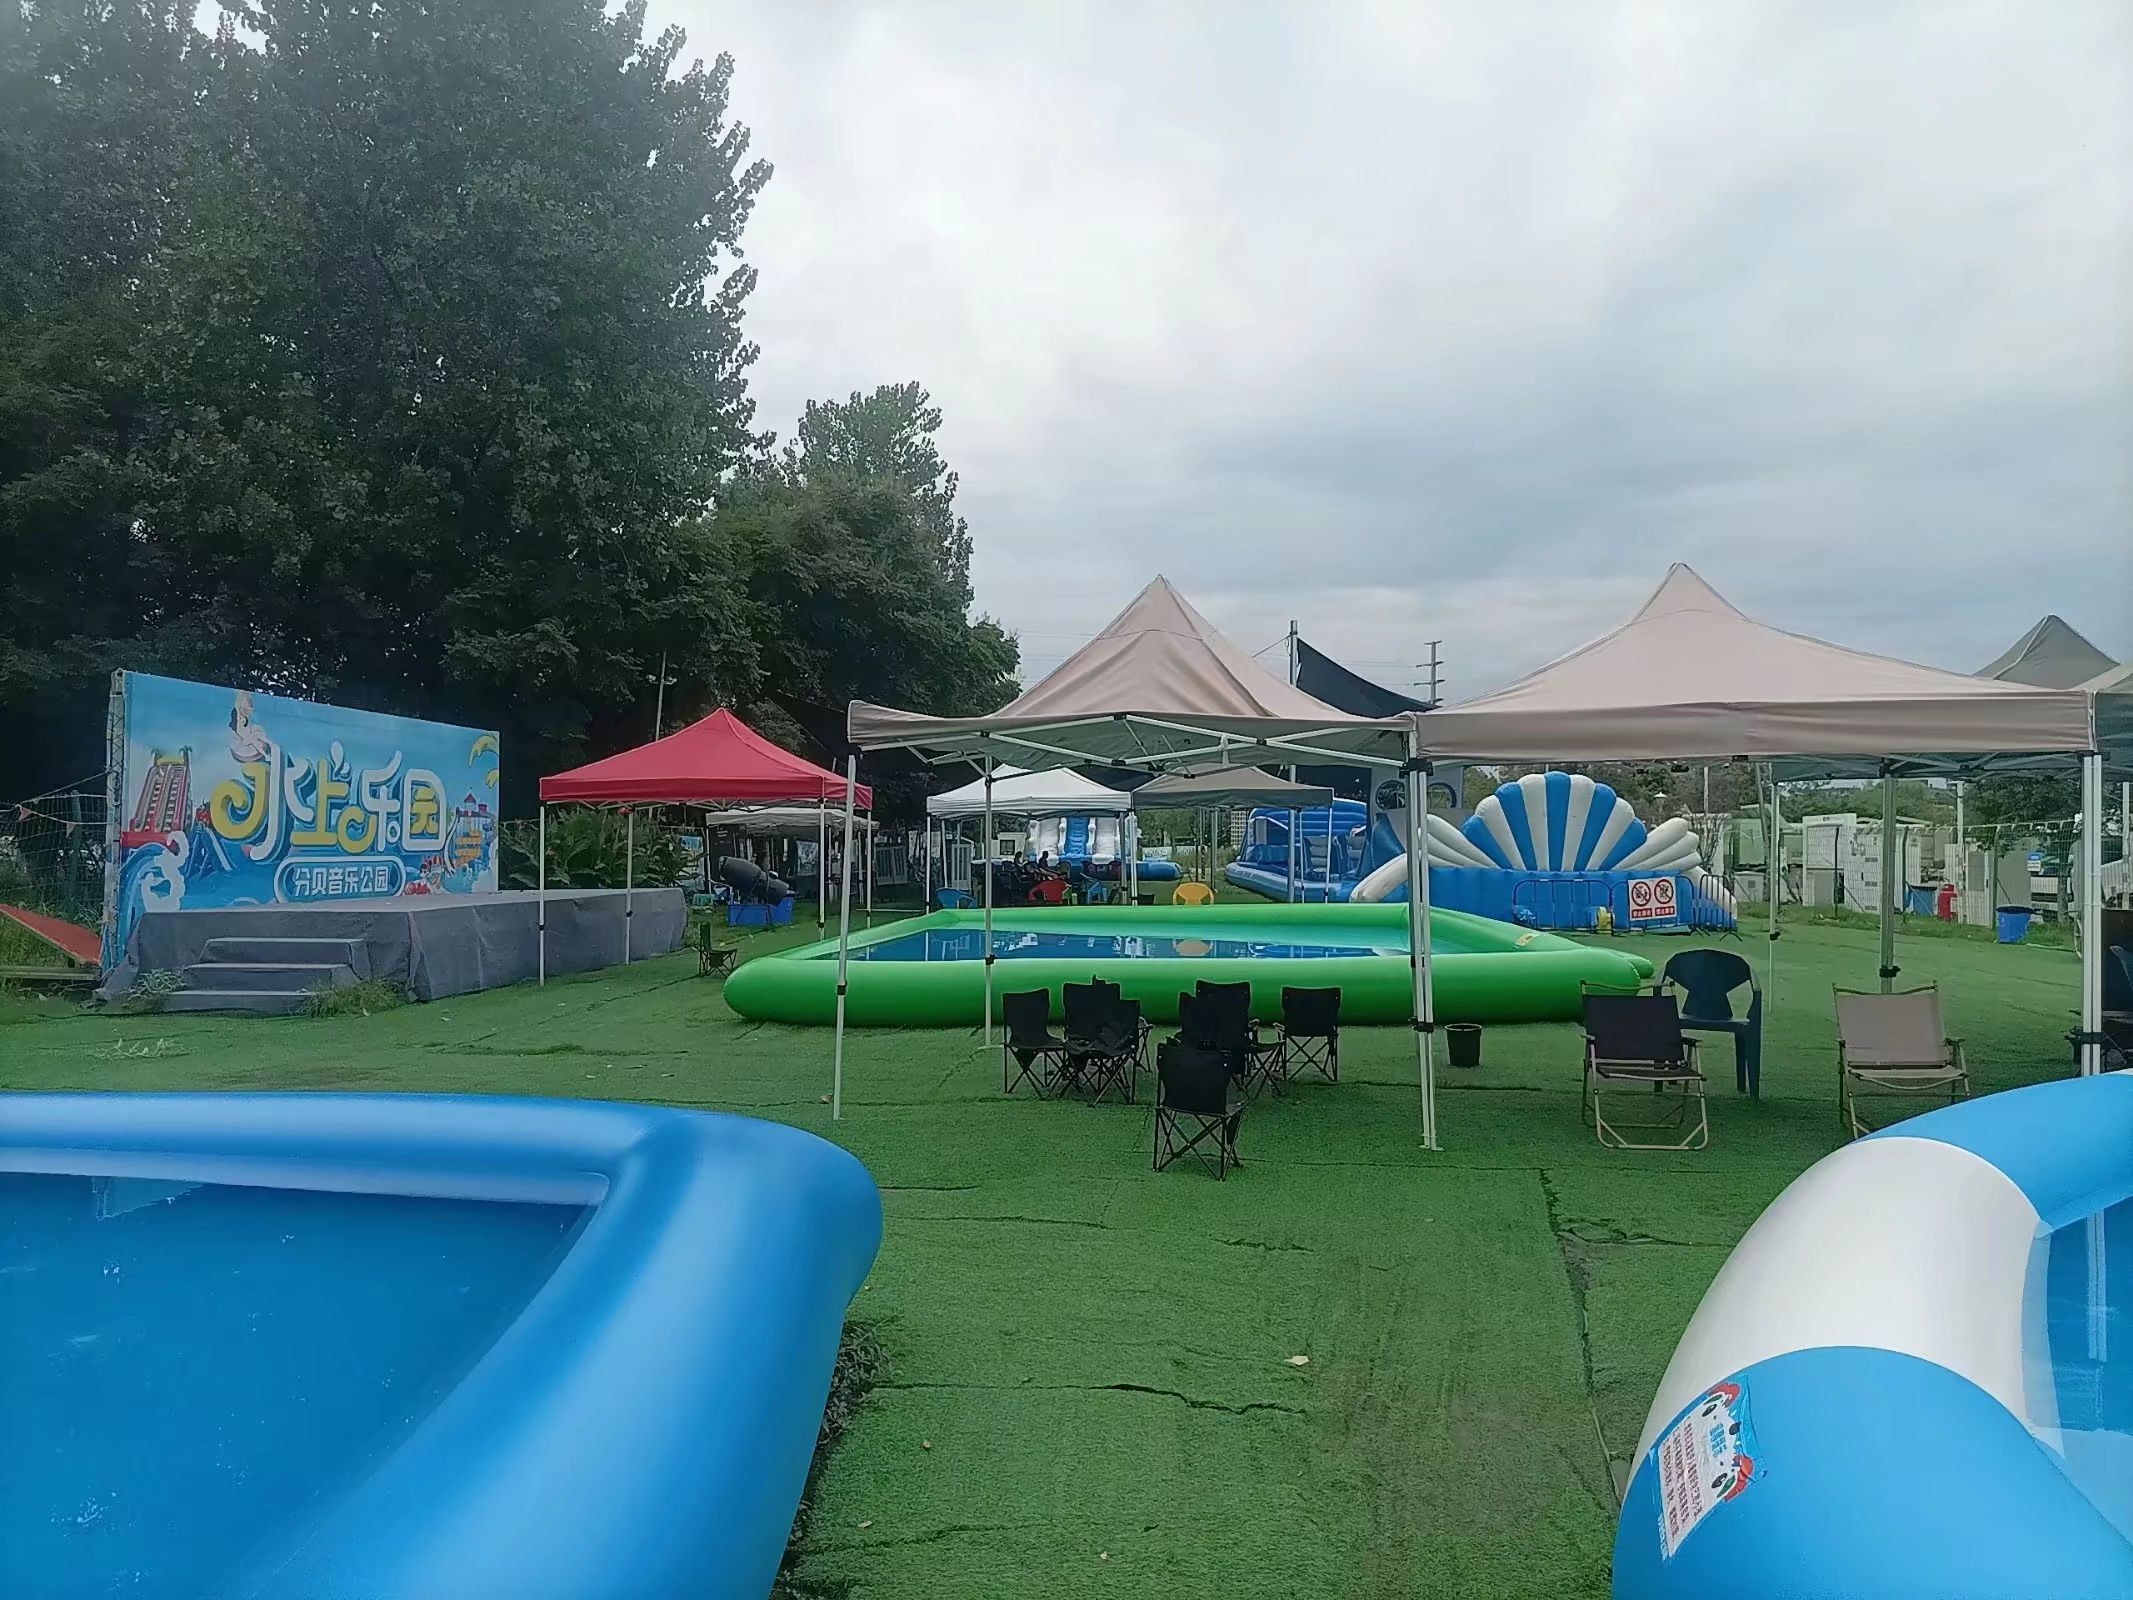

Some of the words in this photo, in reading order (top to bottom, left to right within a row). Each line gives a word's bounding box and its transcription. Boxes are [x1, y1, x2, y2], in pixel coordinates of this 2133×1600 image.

[210, 742, 447, 861] 水上乐园
[293, 866, 390, 897] 分贝音乐公园
